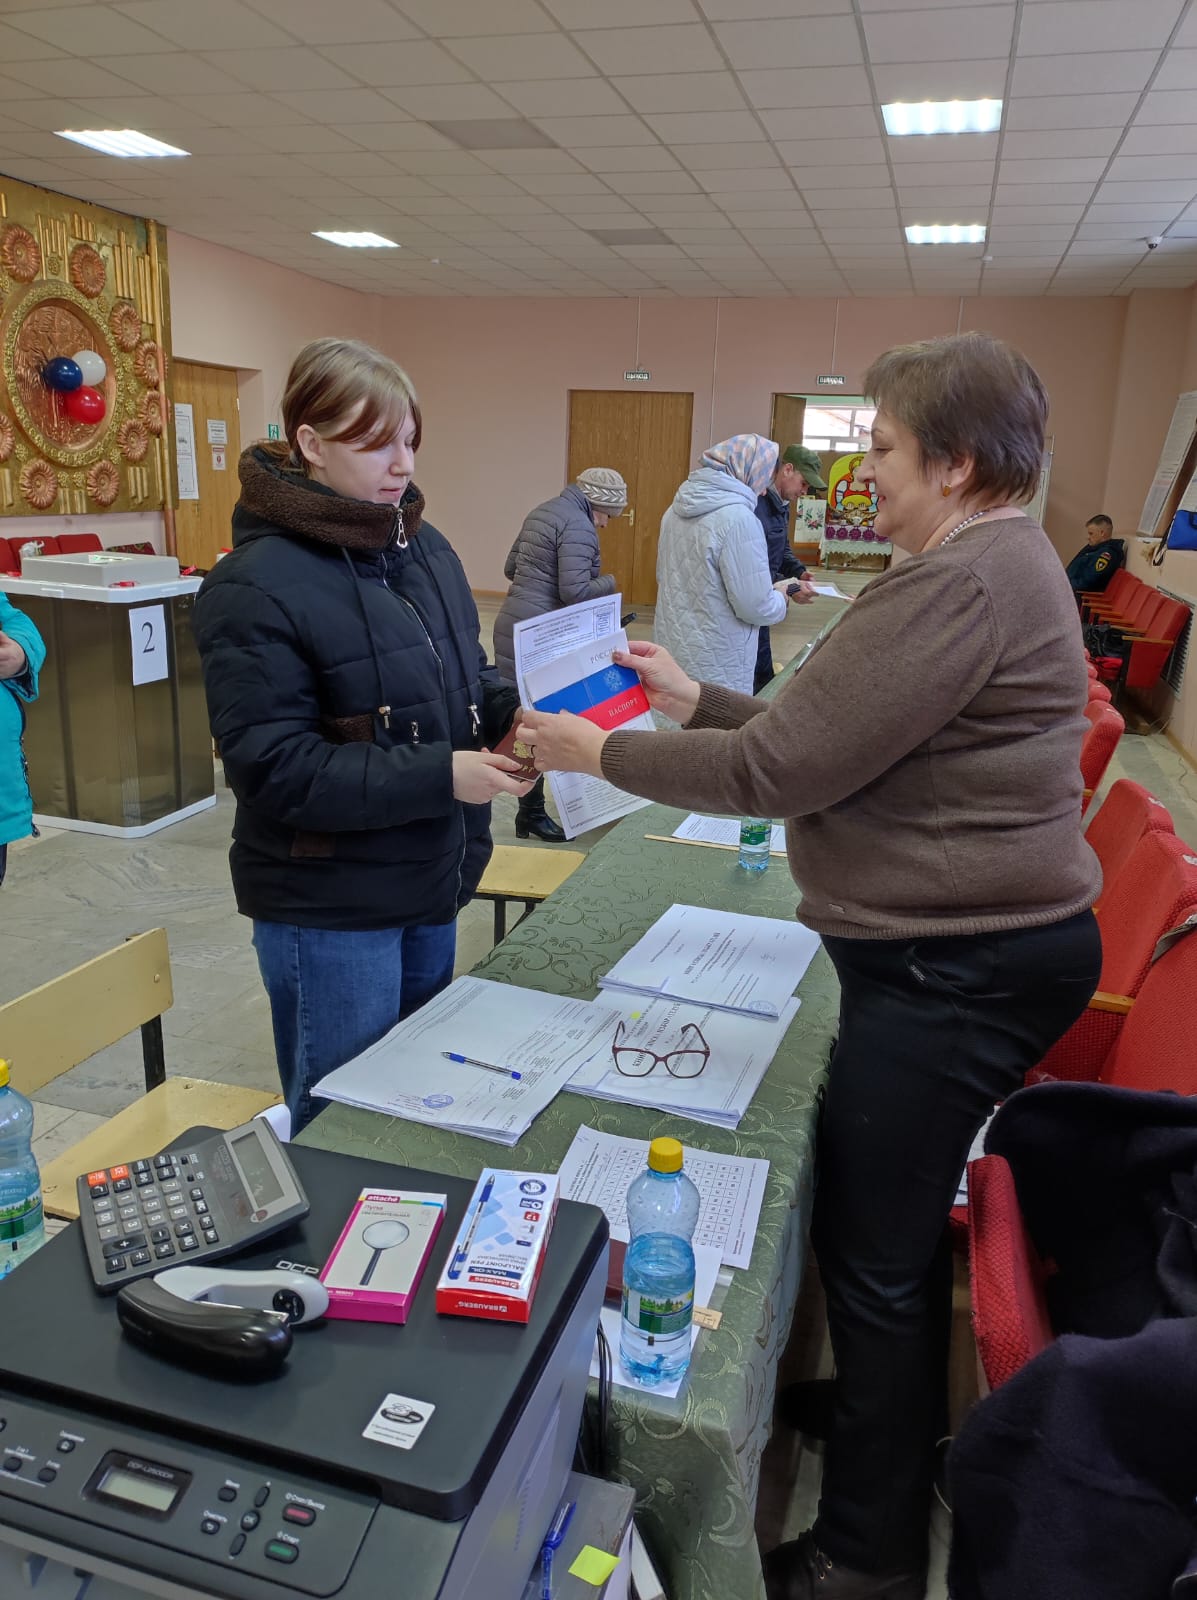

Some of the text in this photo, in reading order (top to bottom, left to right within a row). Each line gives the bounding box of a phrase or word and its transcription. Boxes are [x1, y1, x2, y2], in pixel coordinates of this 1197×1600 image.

[820, 377, 844, 385] ВЫХОД
[141, 621, 155, 653] 2
[608, 697, 638, 717] ПАСПОРТ
[367, 1194, 399, 1202] attaché
[486, 1261, 525, 1270] BALLPOINT
[474, 1276, 510, 1286] BRAUBERG
[459, 1301, 500, 1312] BRAUBERG
[243, 1514, 255, 1524] OK
